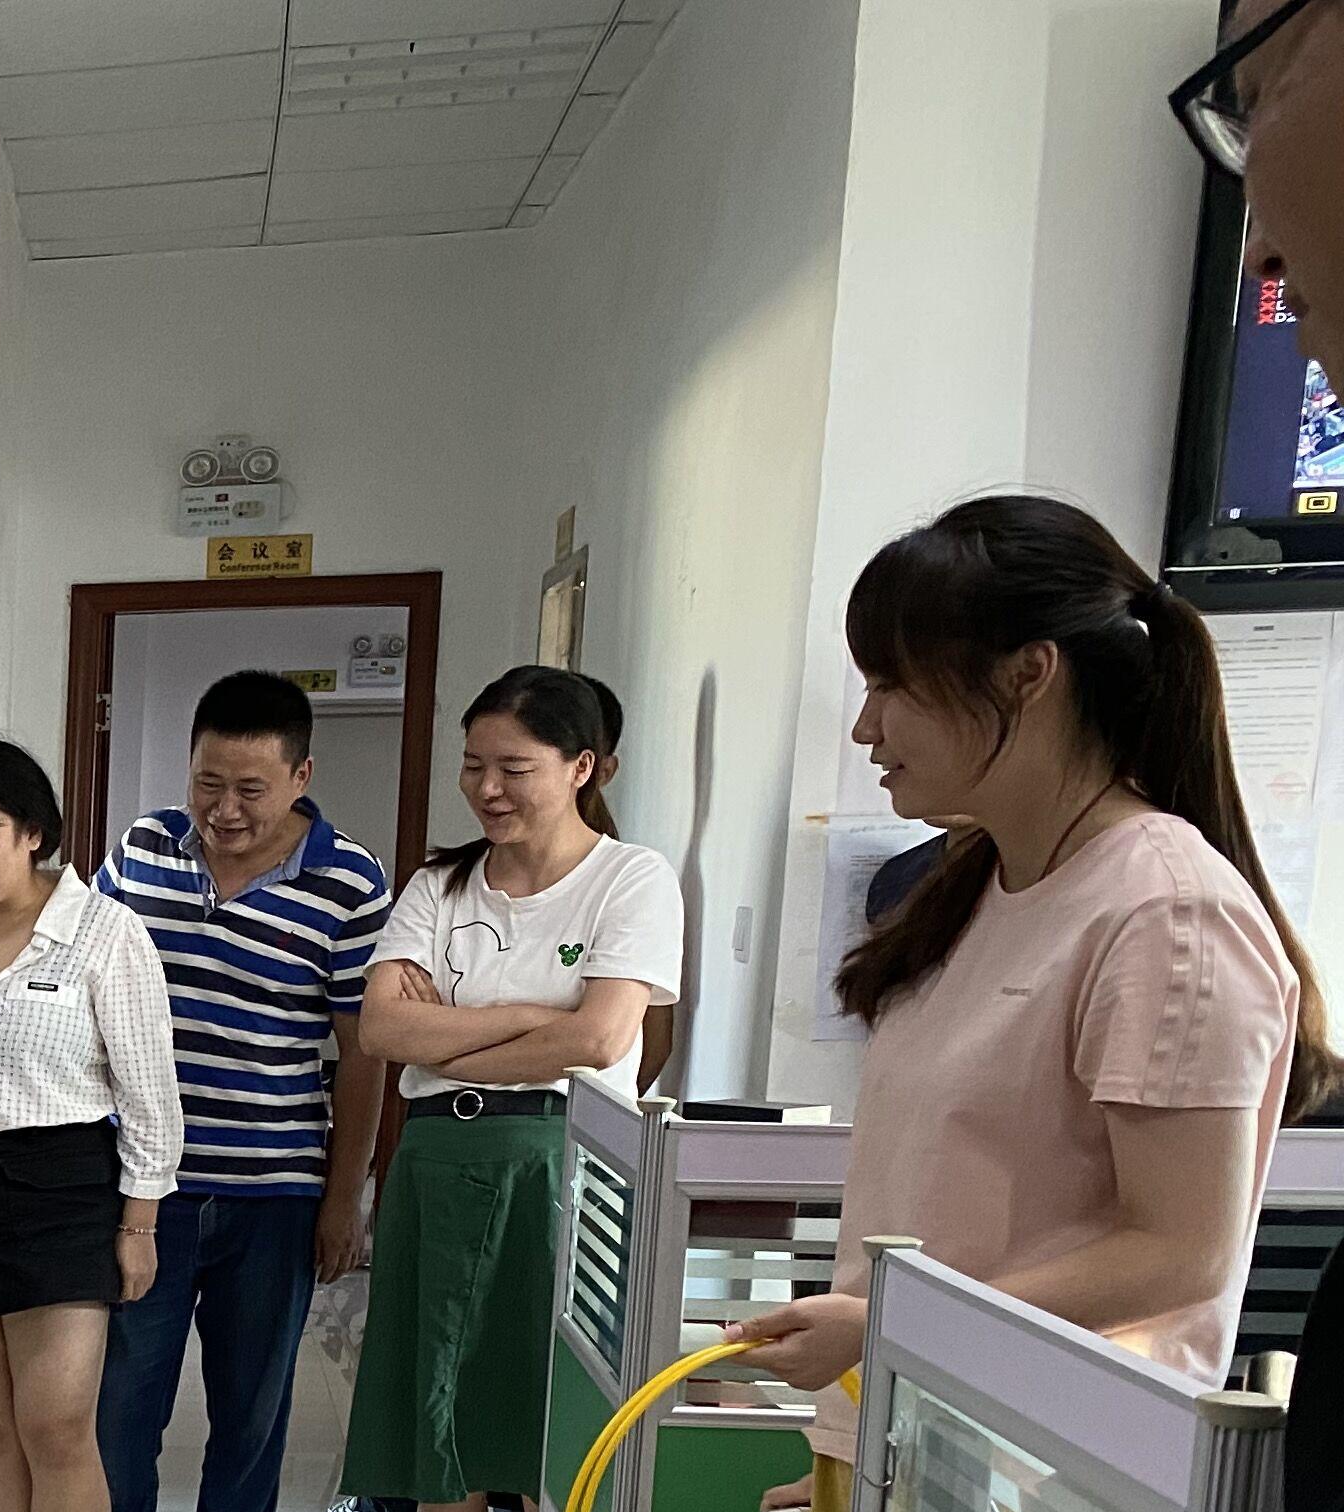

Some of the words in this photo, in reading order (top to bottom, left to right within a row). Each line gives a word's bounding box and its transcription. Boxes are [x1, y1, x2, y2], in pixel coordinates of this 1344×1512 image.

[217, 541, 303, 561] 会议室
[219, 563, 271, 573] Conference
[273, 561, 300, 571] Room
